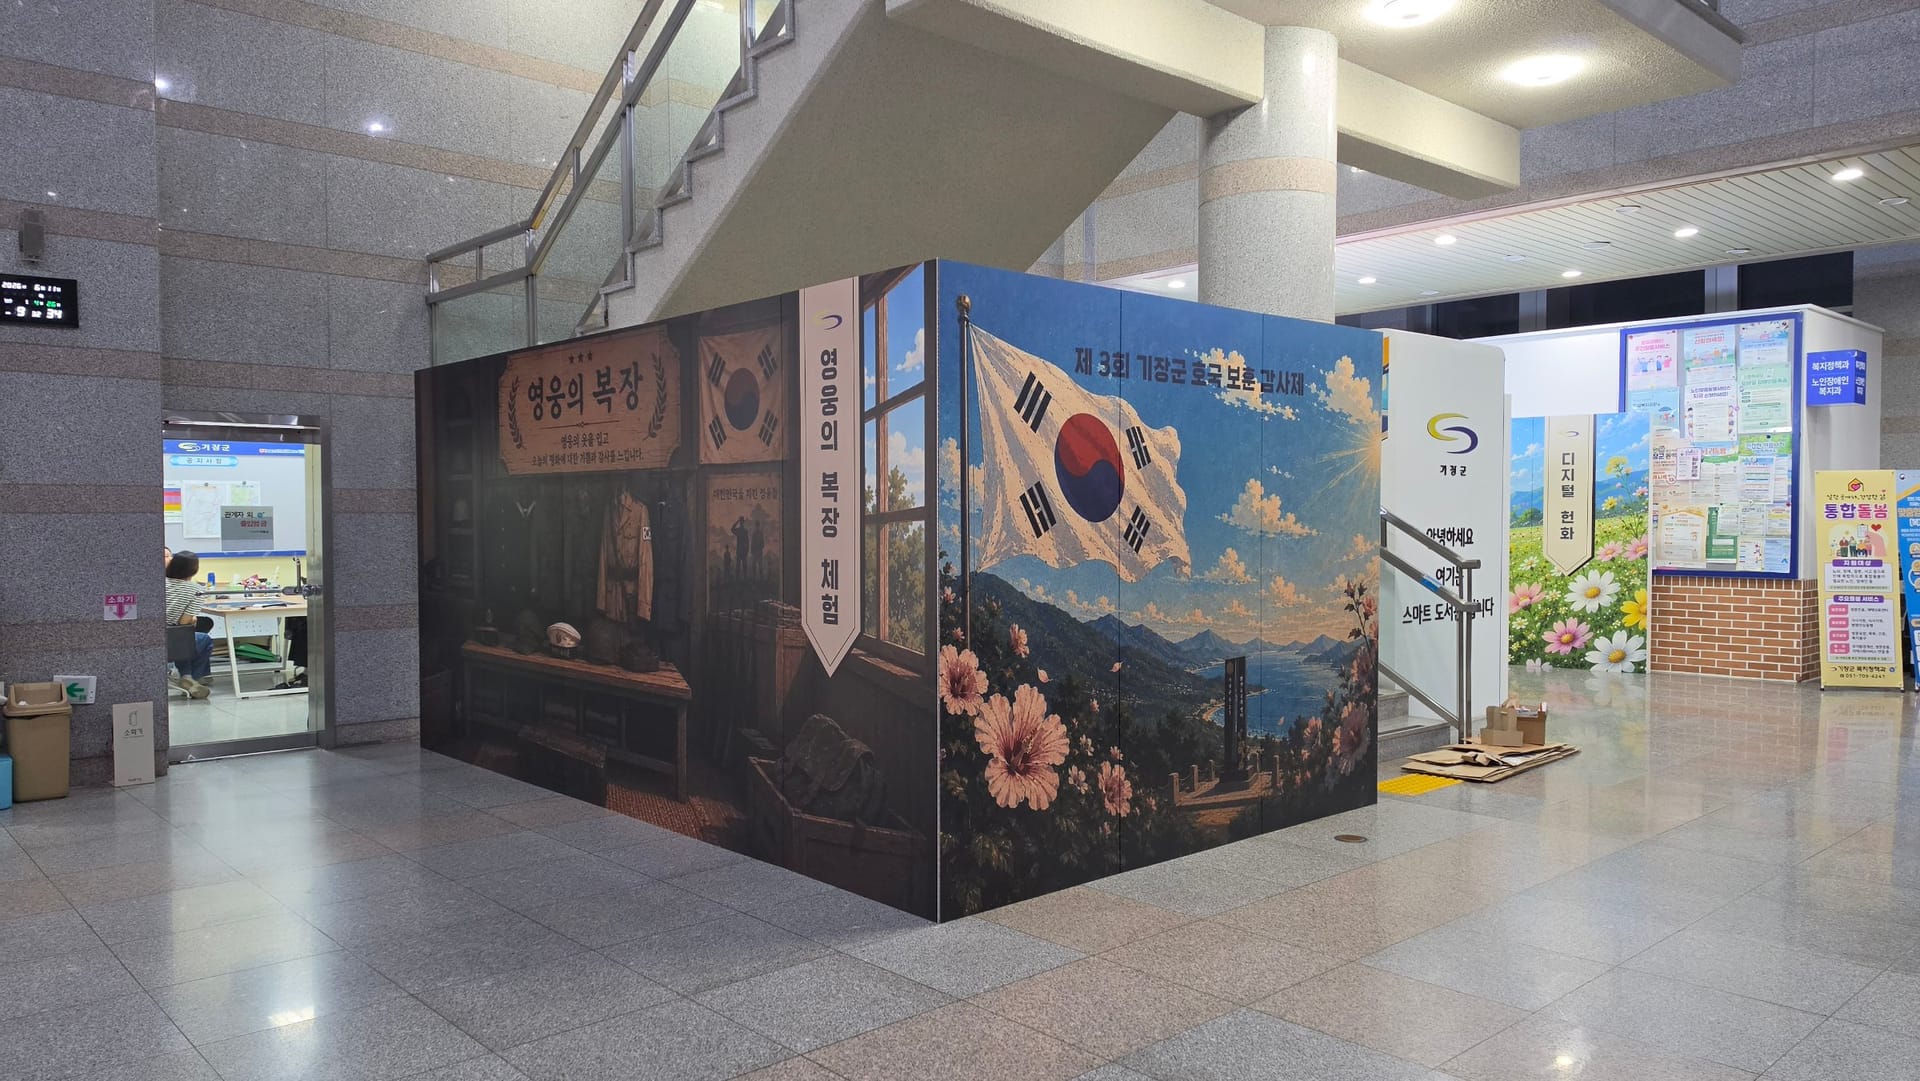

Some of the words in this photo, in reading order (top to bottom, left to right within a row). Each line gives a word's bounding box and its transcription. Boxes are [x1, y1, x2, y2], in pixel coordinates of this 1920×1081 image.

[1074, 347, 1092, 376] 제
[1099, 351, 1130, 379] 3회
[1136, 354, 1187, 385] 기장군
[1191, 359, 1222, 388] 호국
[1226, 364, 1256, 391] 보훈
[1260, 368, 1304, 396] 감사제
[1812, 360, 1849, 371] 복지정책과
[527, 372, 583, 421] 영웅의
[592, 361, 643, 414] 복장
[1811, 376, 1849, 387] 노인장애인
[1819, 386, 1841, 396] 복지과
[820, 348, 840, 451] 영웅의
[581, 432, 595, 447] 옷을
[596, 432, 609, 446] 입고
[1439, 464, 1467, 476] 기장군
[1561, 452, 1575, 498] 디지털
[820, 472, 840, 538] 복장
[1824, 503, 1888, 519] 통합돌봄
[1560, 510, 1574, 541] 헌화
[1426, 527, 1474, 547] 안녕하세요
[107, 594, 134, 604] 소화기
[820, 558, 840, 626] 체험
[1402, 604, 1432, 625] 스마트
[124, 728, 143, 737] 소화기
